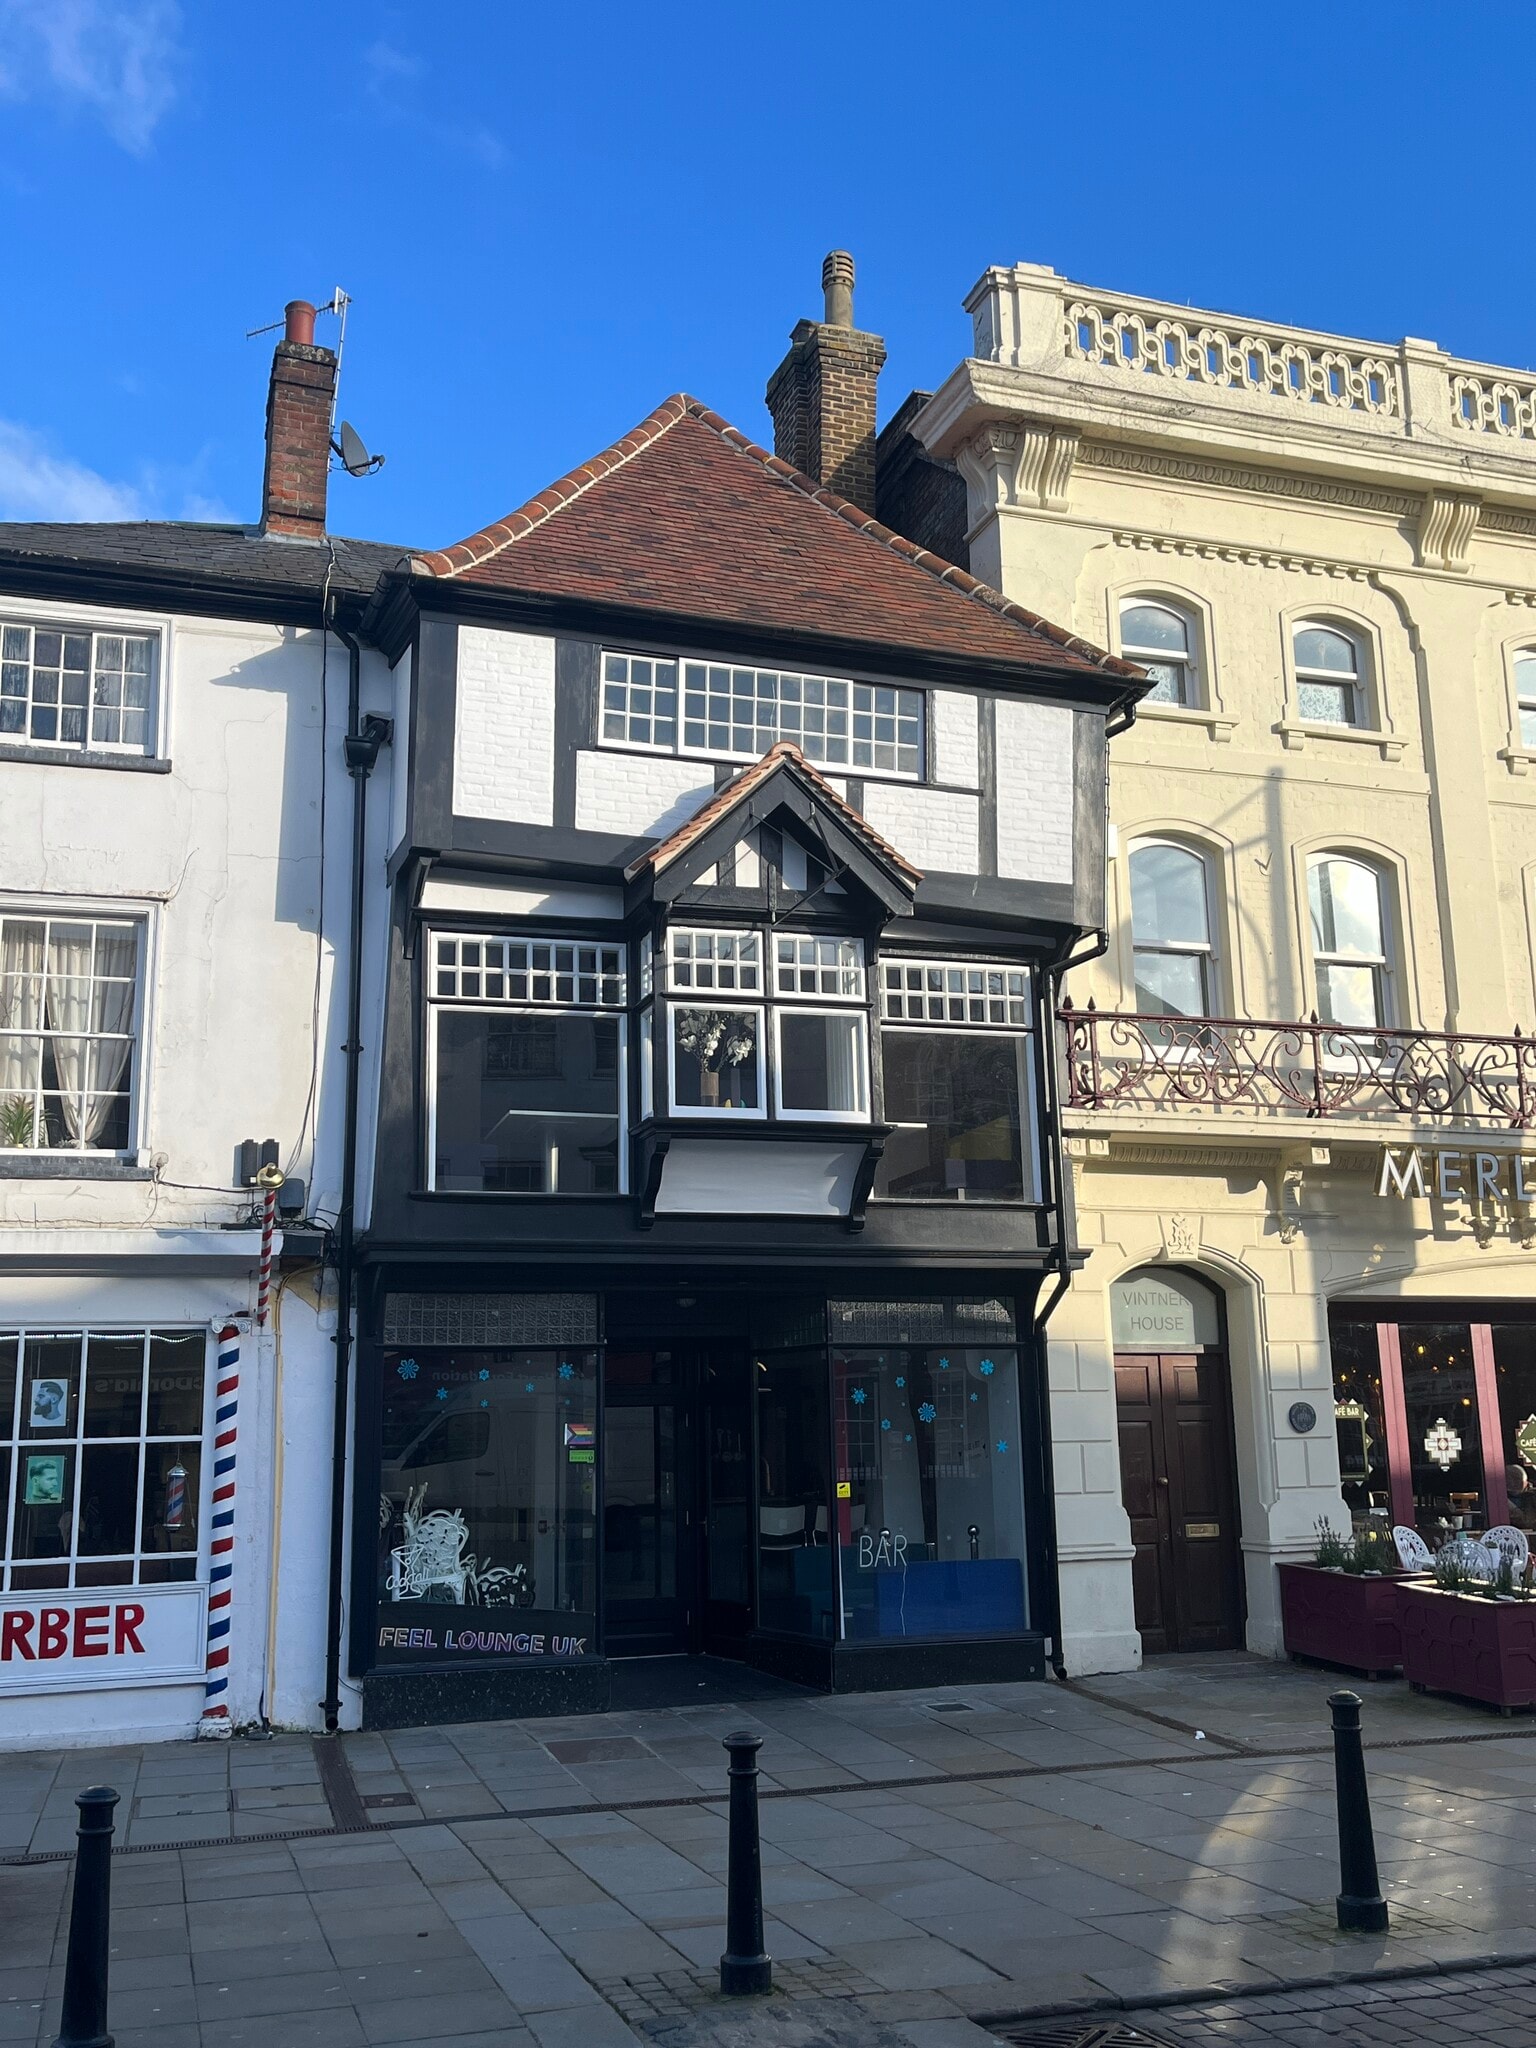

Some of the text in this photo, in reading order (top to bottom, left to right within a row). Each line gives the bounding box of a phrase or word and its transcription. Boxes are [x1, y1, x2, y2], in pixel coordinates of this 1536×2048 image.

[1377, 1148, 1536, 1201] MERL
[1130, 1316, 1185, 1331] HOUSE
[1346, 1407, 1360, 1416] BAR
[859, 1535, 908, 1568] BAR
[1, 1604, 146, 1661] RBER
[379, 1627, 588, 1655] FEEL LOUNGE UK
